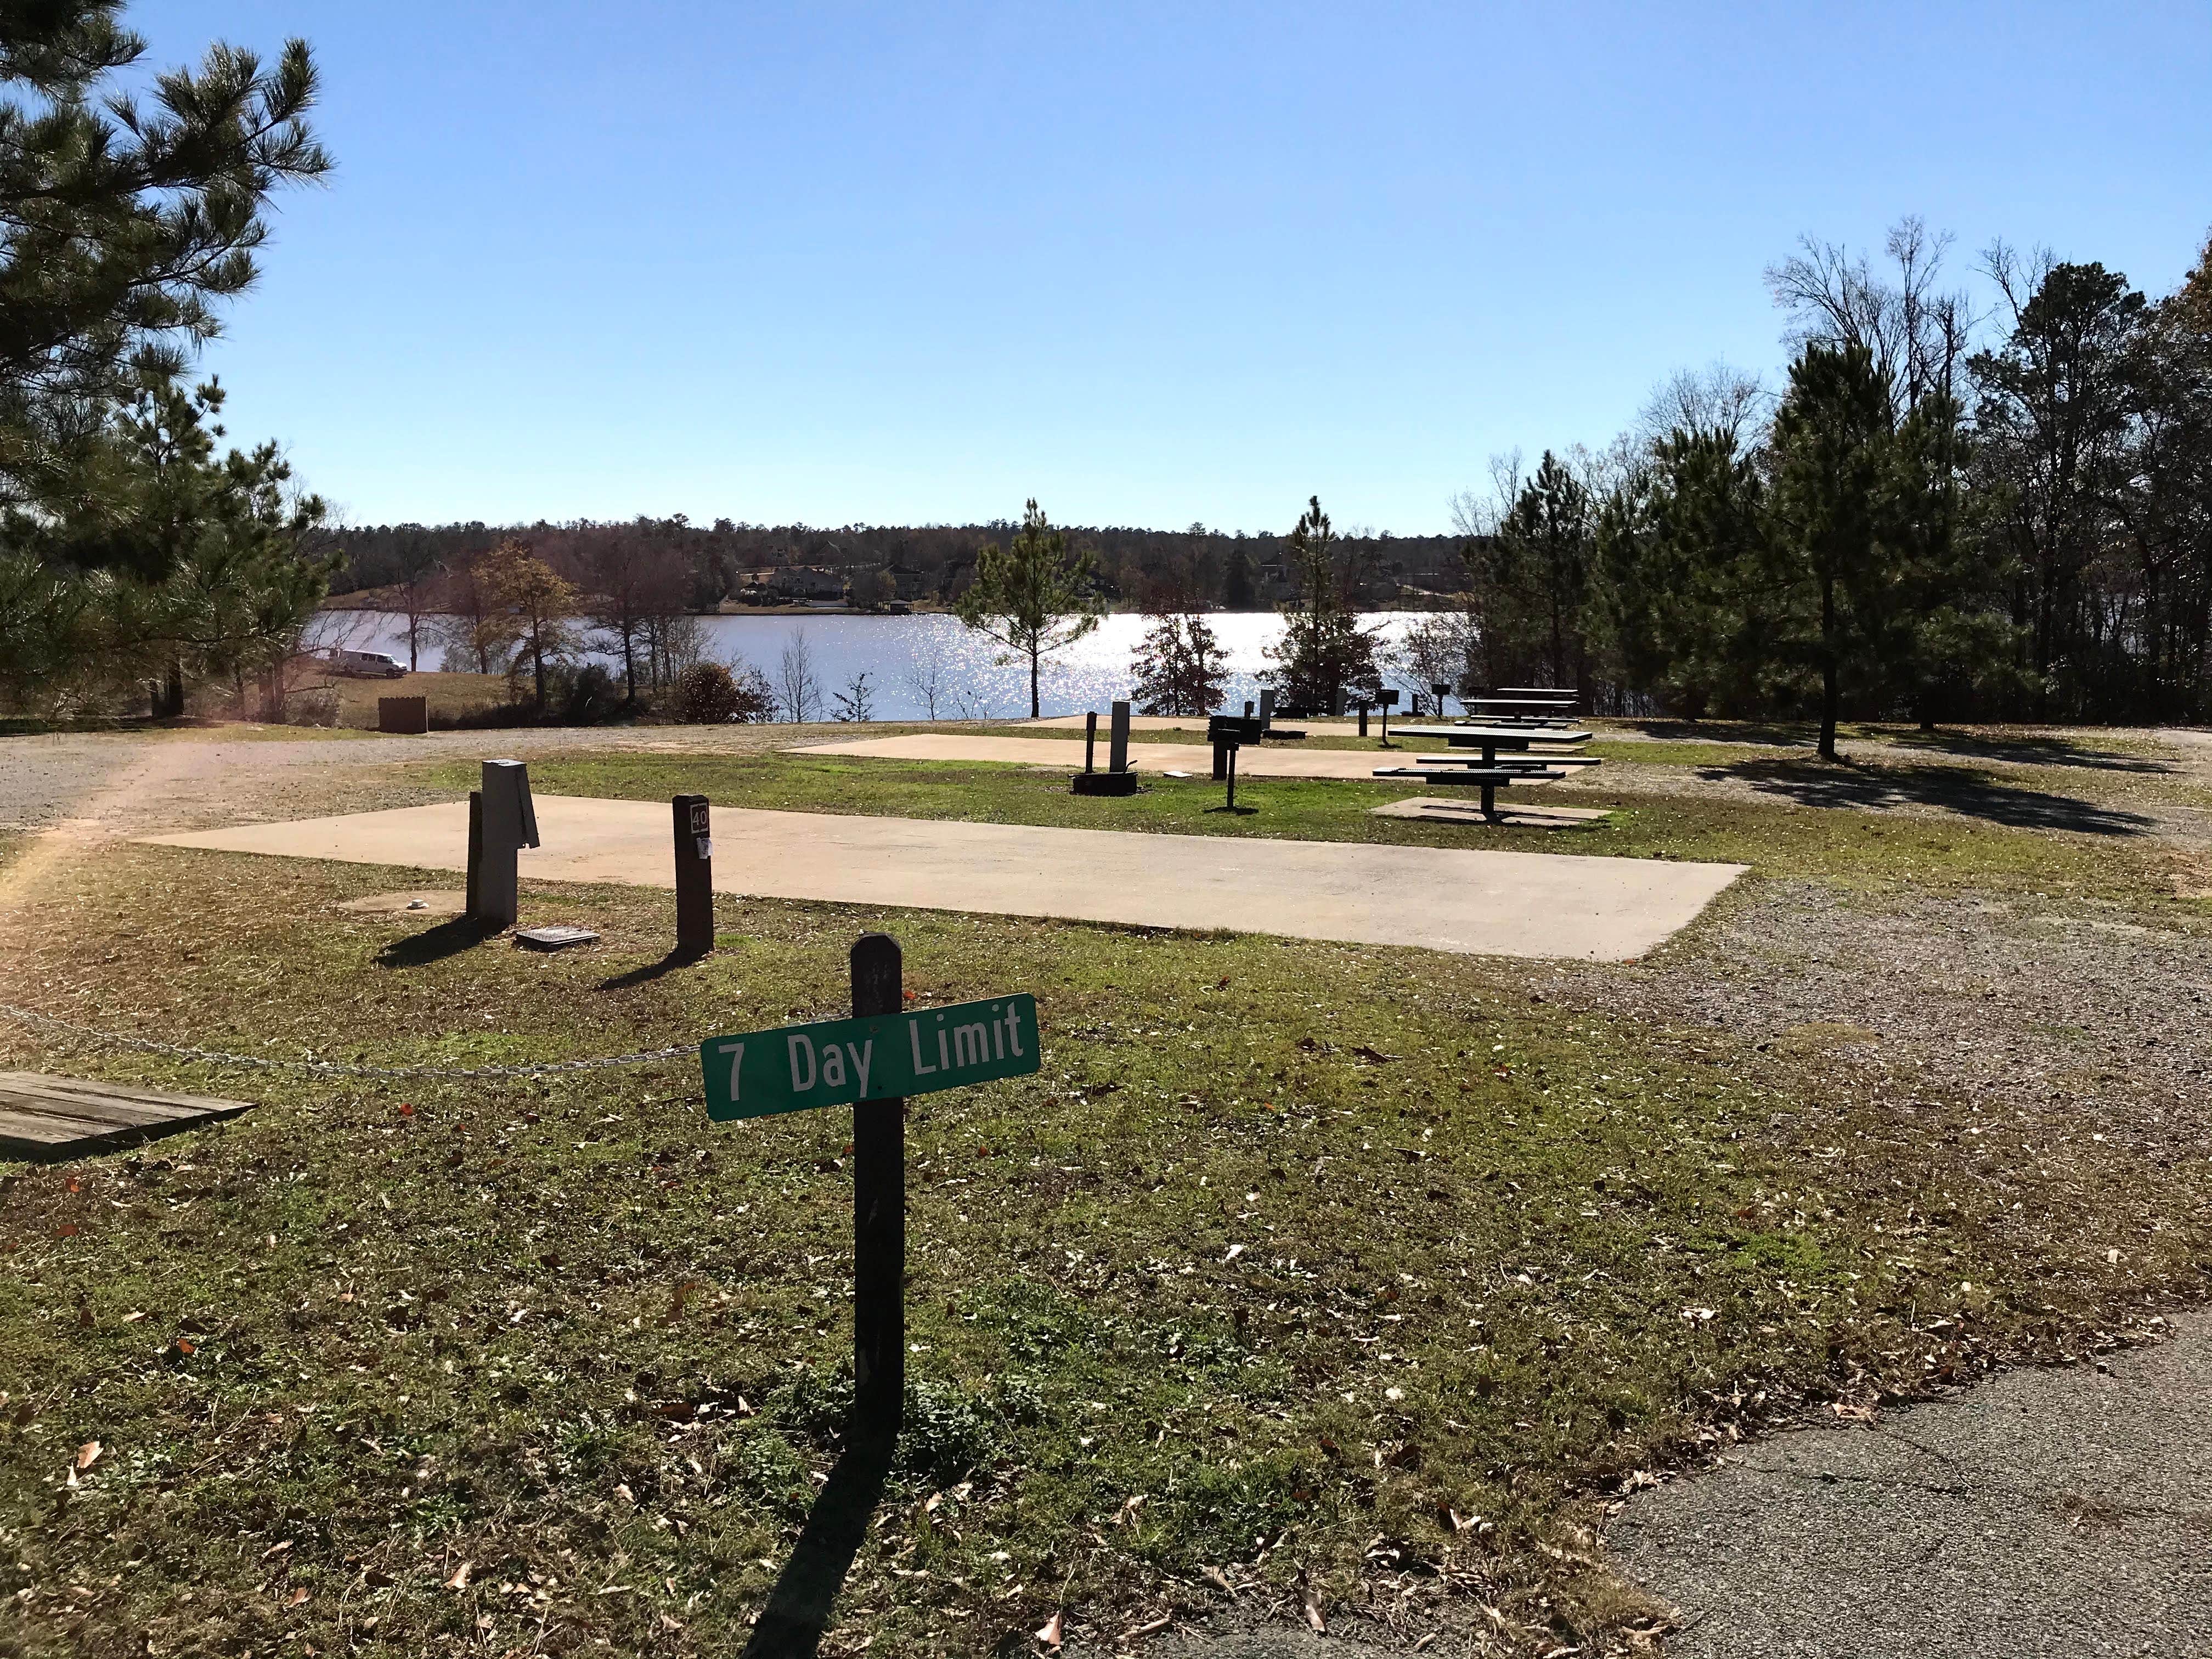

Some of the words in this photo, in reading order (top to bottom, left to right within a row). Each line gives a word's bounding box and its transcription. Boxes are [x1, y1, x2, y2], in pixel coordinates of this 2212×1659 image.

[692, 811, 707, 825] 40
[719, 1043, 744, 1101] 7
[787, 1034, 873, 1098] Day
[909, 1002, 1024, 1075] Limit
